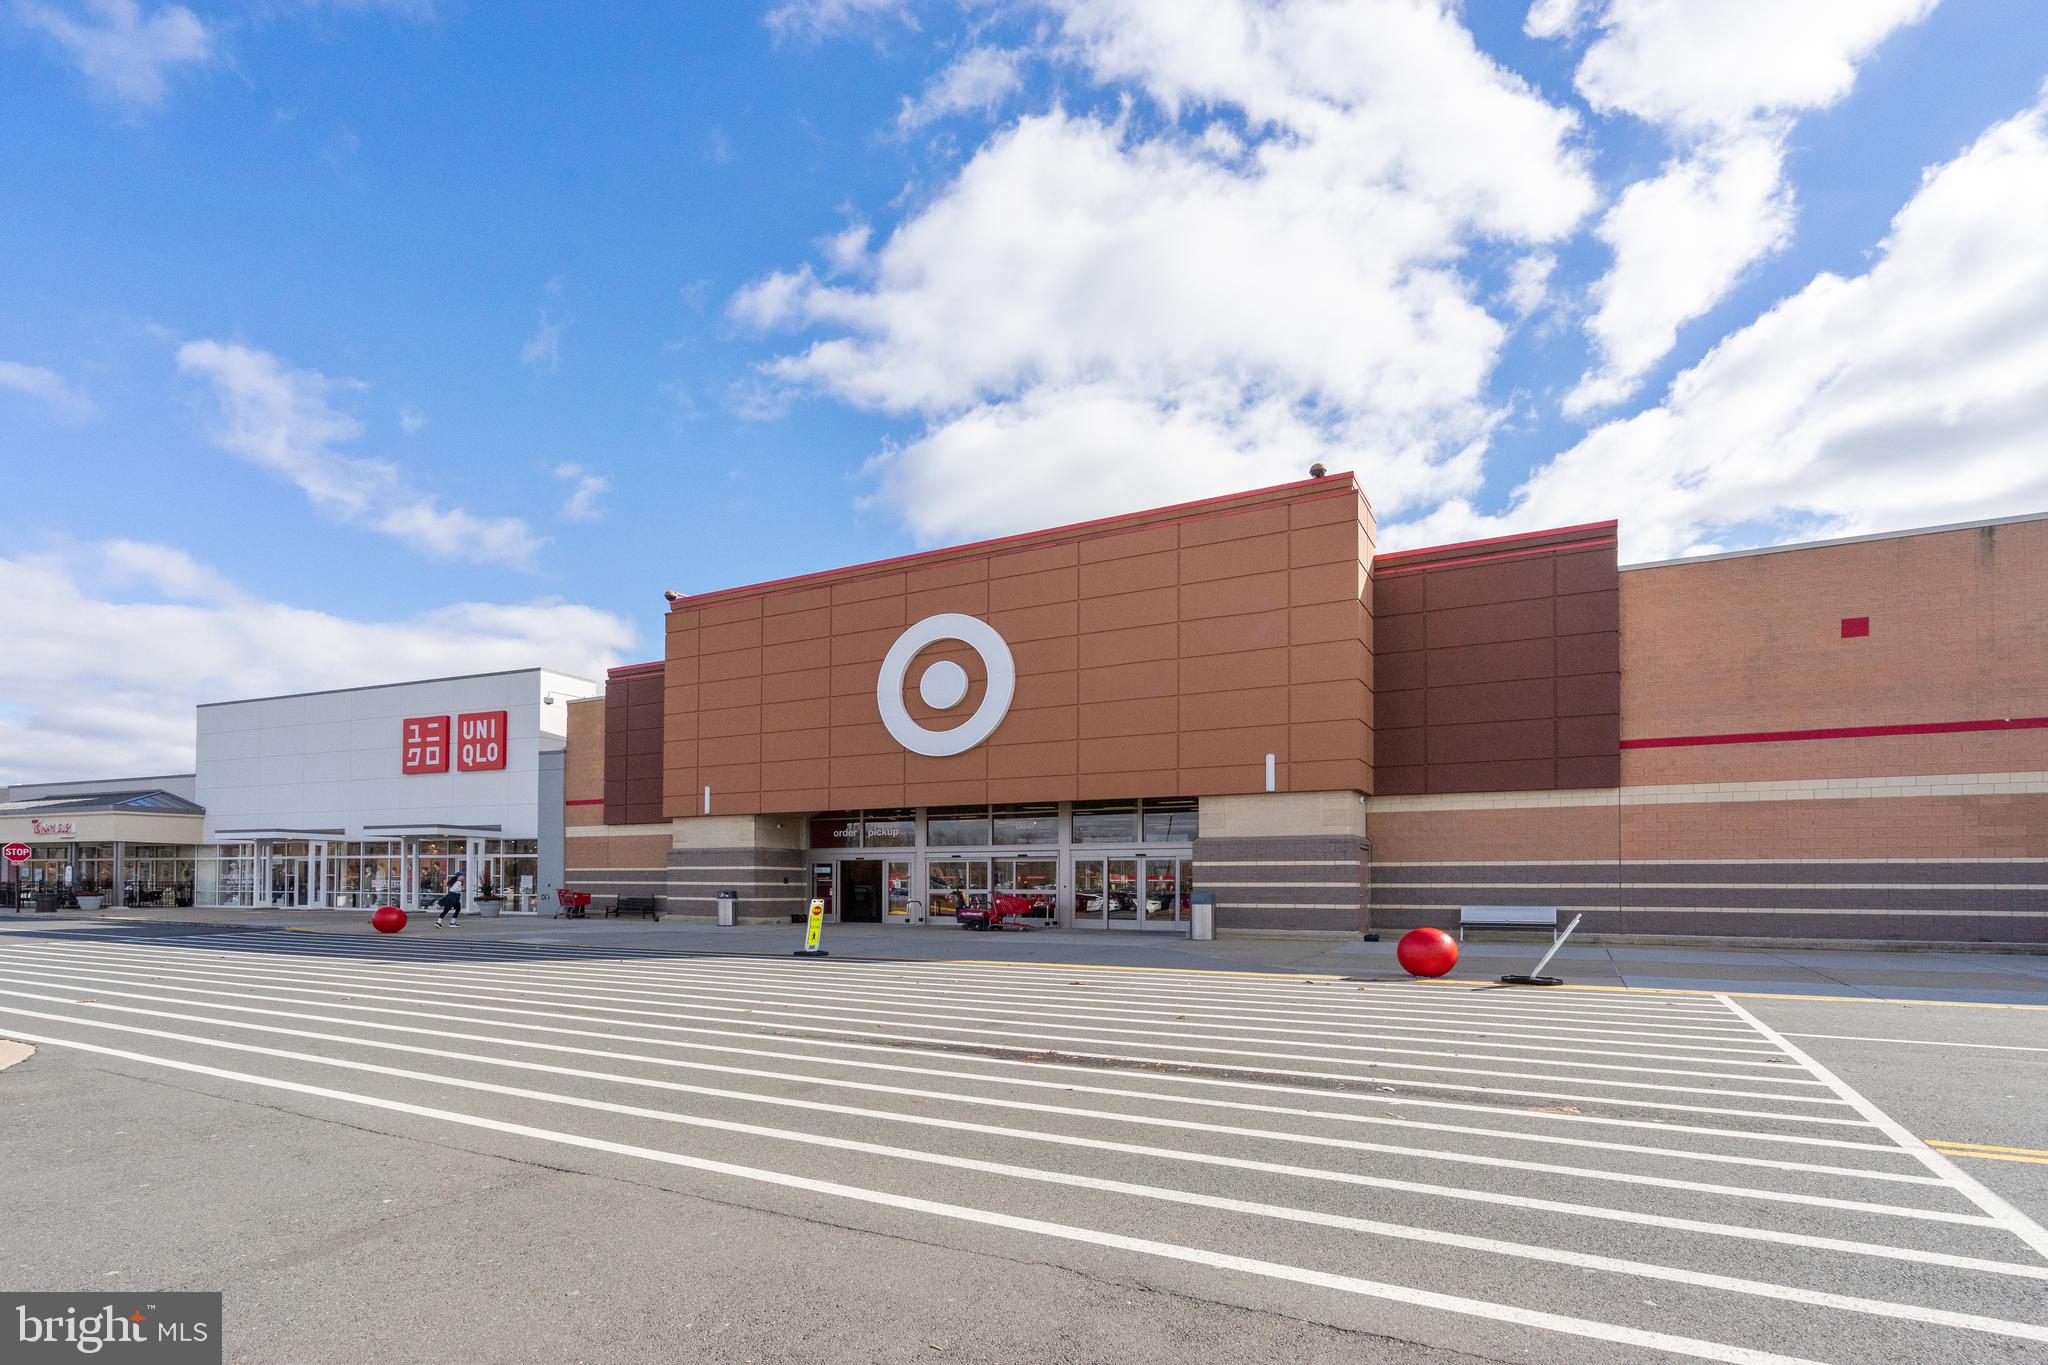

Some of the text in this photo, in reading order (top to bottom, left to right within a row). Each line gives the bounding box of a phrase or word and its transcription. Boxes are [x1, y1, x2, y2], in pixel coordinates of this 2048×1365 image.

[408, 722, 440, 743] ユニ
[463, 719, 495, 740] UNI
[407, 746, 440, 767] クロ
[462, 742, 499, 767] QLO
[833, 828, 899, 838] order pickup
[5, 848, 29, 856] STOP
